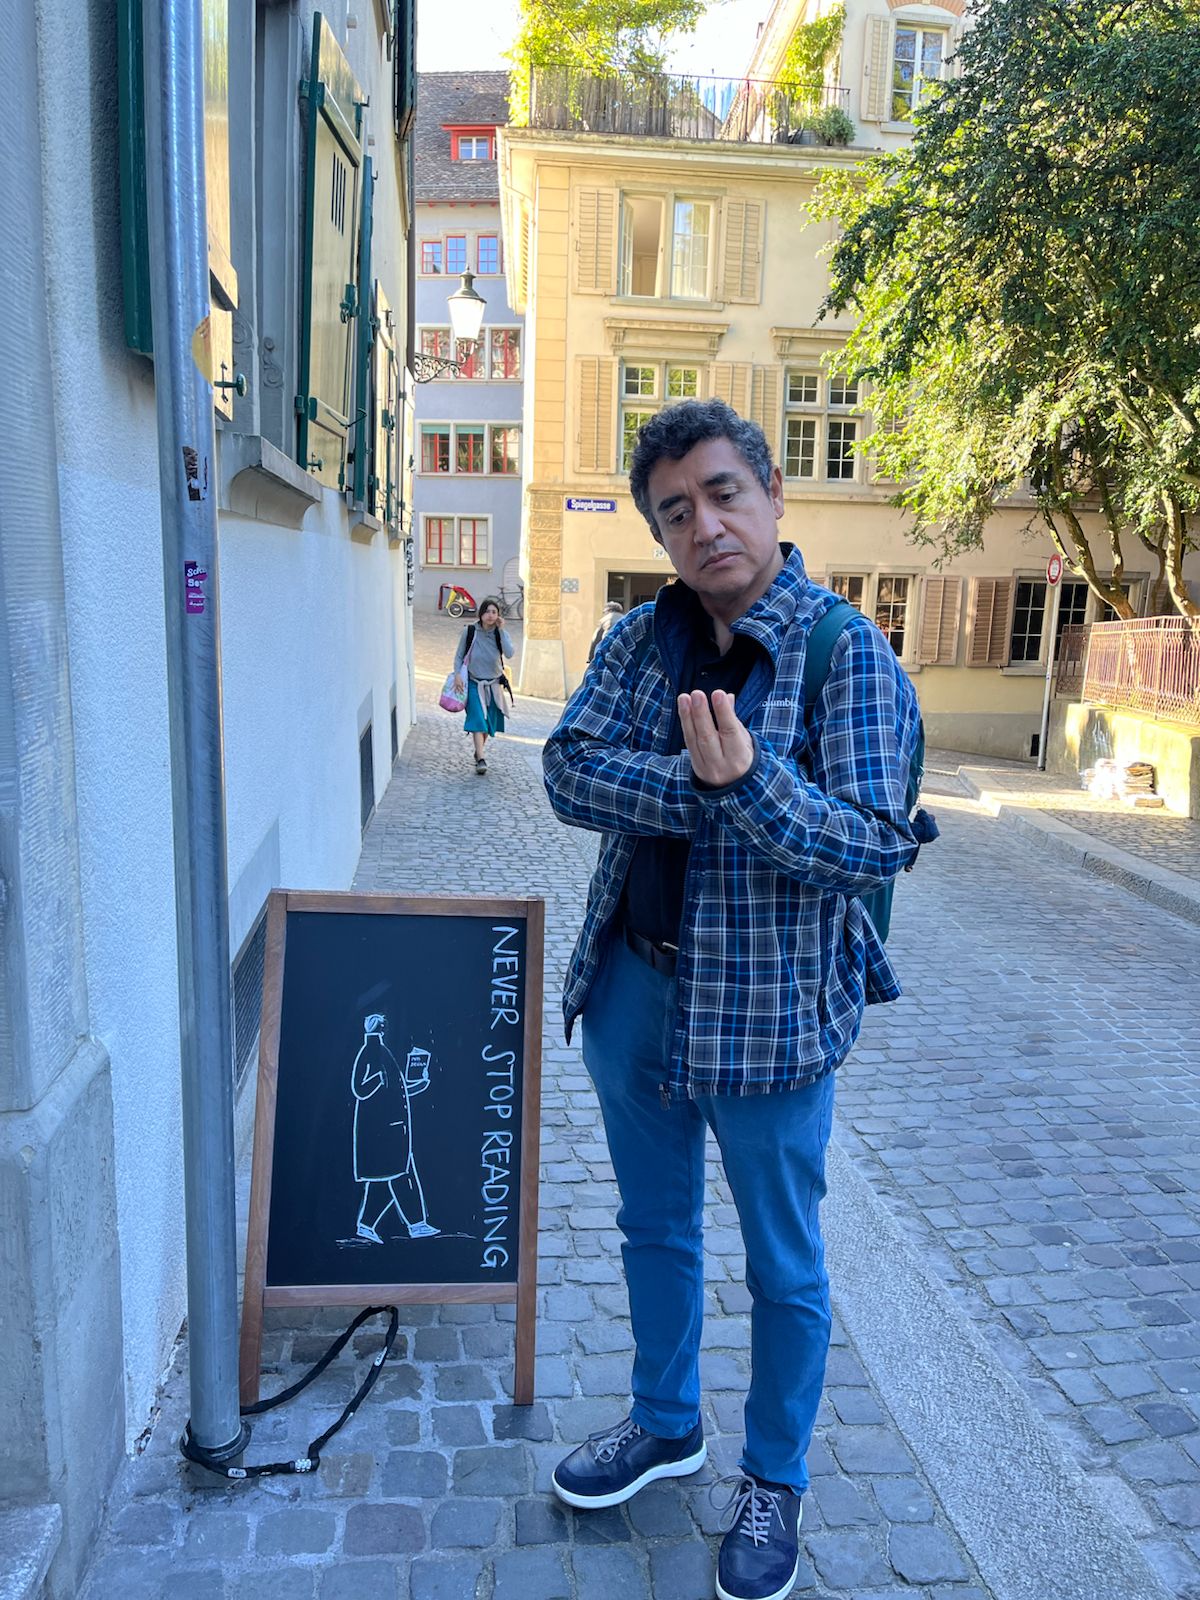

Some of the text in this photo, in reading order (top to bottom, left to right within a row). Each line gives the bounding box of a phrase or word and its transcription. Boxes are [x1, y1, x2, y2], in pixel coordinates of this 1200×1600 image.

[571, 499, 611, 511] Spiegelgasse
[760, 697, 799, 708] olumbia
[480, 926, 519, 1268] NEVER STOP READING
